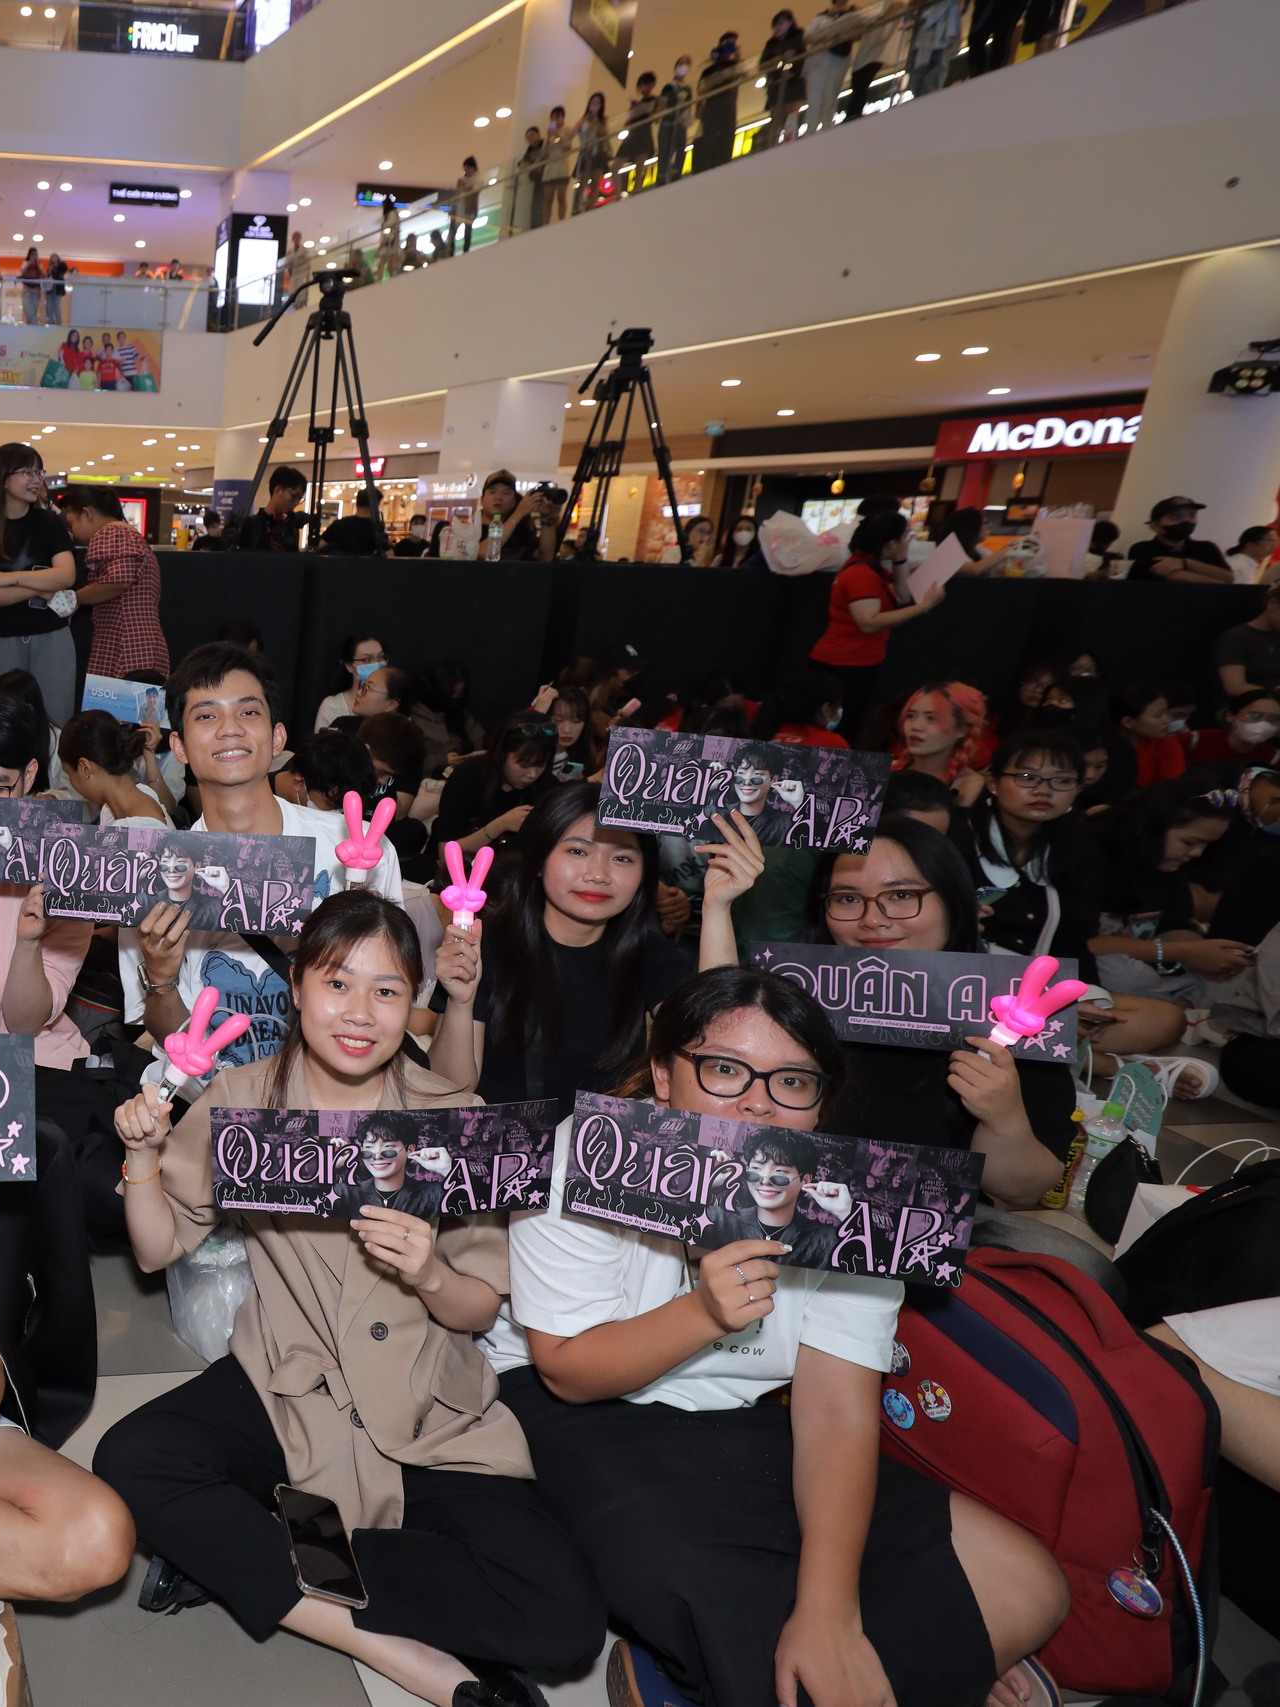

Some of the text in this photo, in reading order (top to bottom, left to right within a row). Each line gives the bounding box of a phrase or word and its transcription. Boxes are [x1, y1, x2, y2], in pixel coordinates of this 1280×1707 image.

[132, 21, 177, 52] FRICO
[609, 744, 734, 808] Quân
[4, 837, 46, 883] A.
[48, 838, 158, 897] Quân
[217, 1124, 360, 1189] Quân
[575, 1114, 747, 1212] Quân
[573, 1203, 677, 1233] Hip Family always by your side
[729, 1345, 766, 1356] cow
